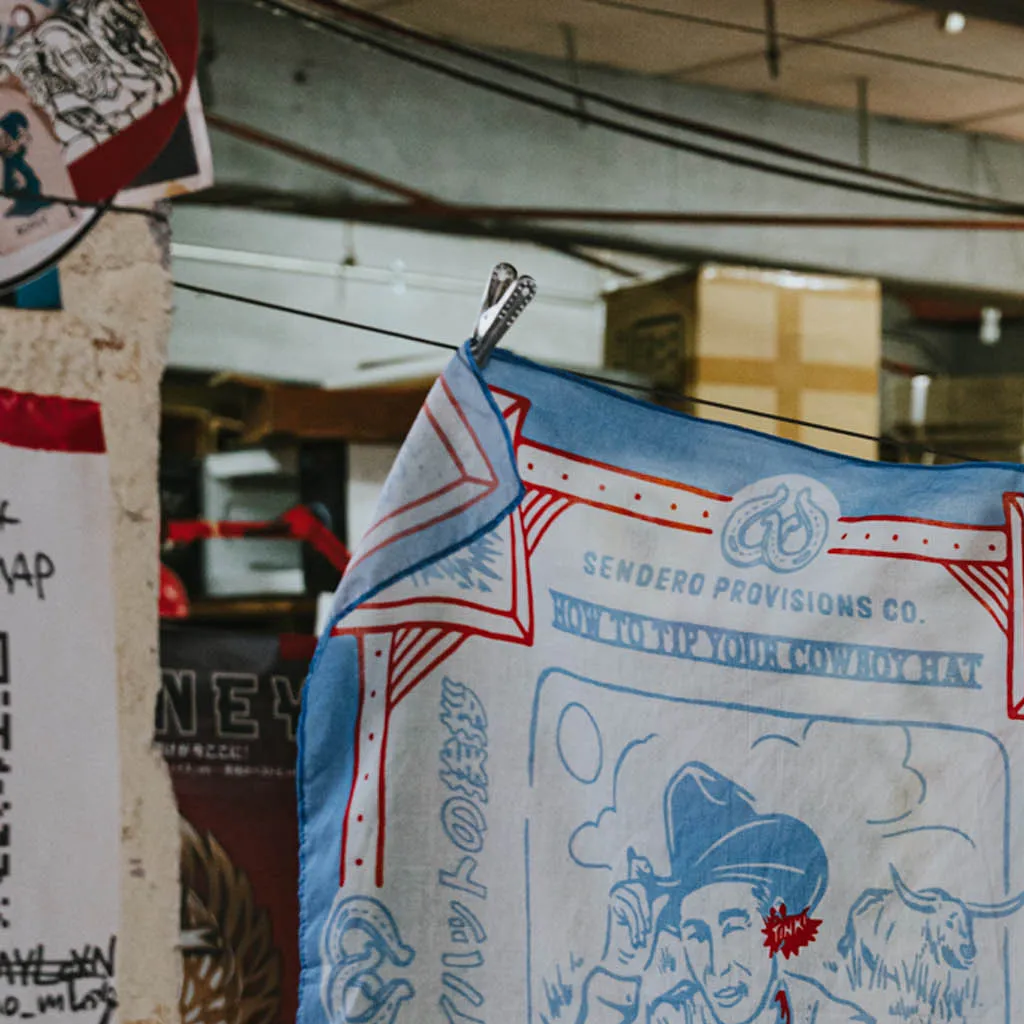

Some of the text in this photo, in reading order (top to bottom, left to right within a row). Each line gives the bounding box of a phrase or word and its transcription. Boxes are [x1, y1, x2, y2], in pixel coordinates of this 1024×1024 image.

[581, 550, 927, 626] SENDERO PROVISIONS CO.
[551, 592, 984, 690] HOW TO TIP YOUR COWBOY HAT
